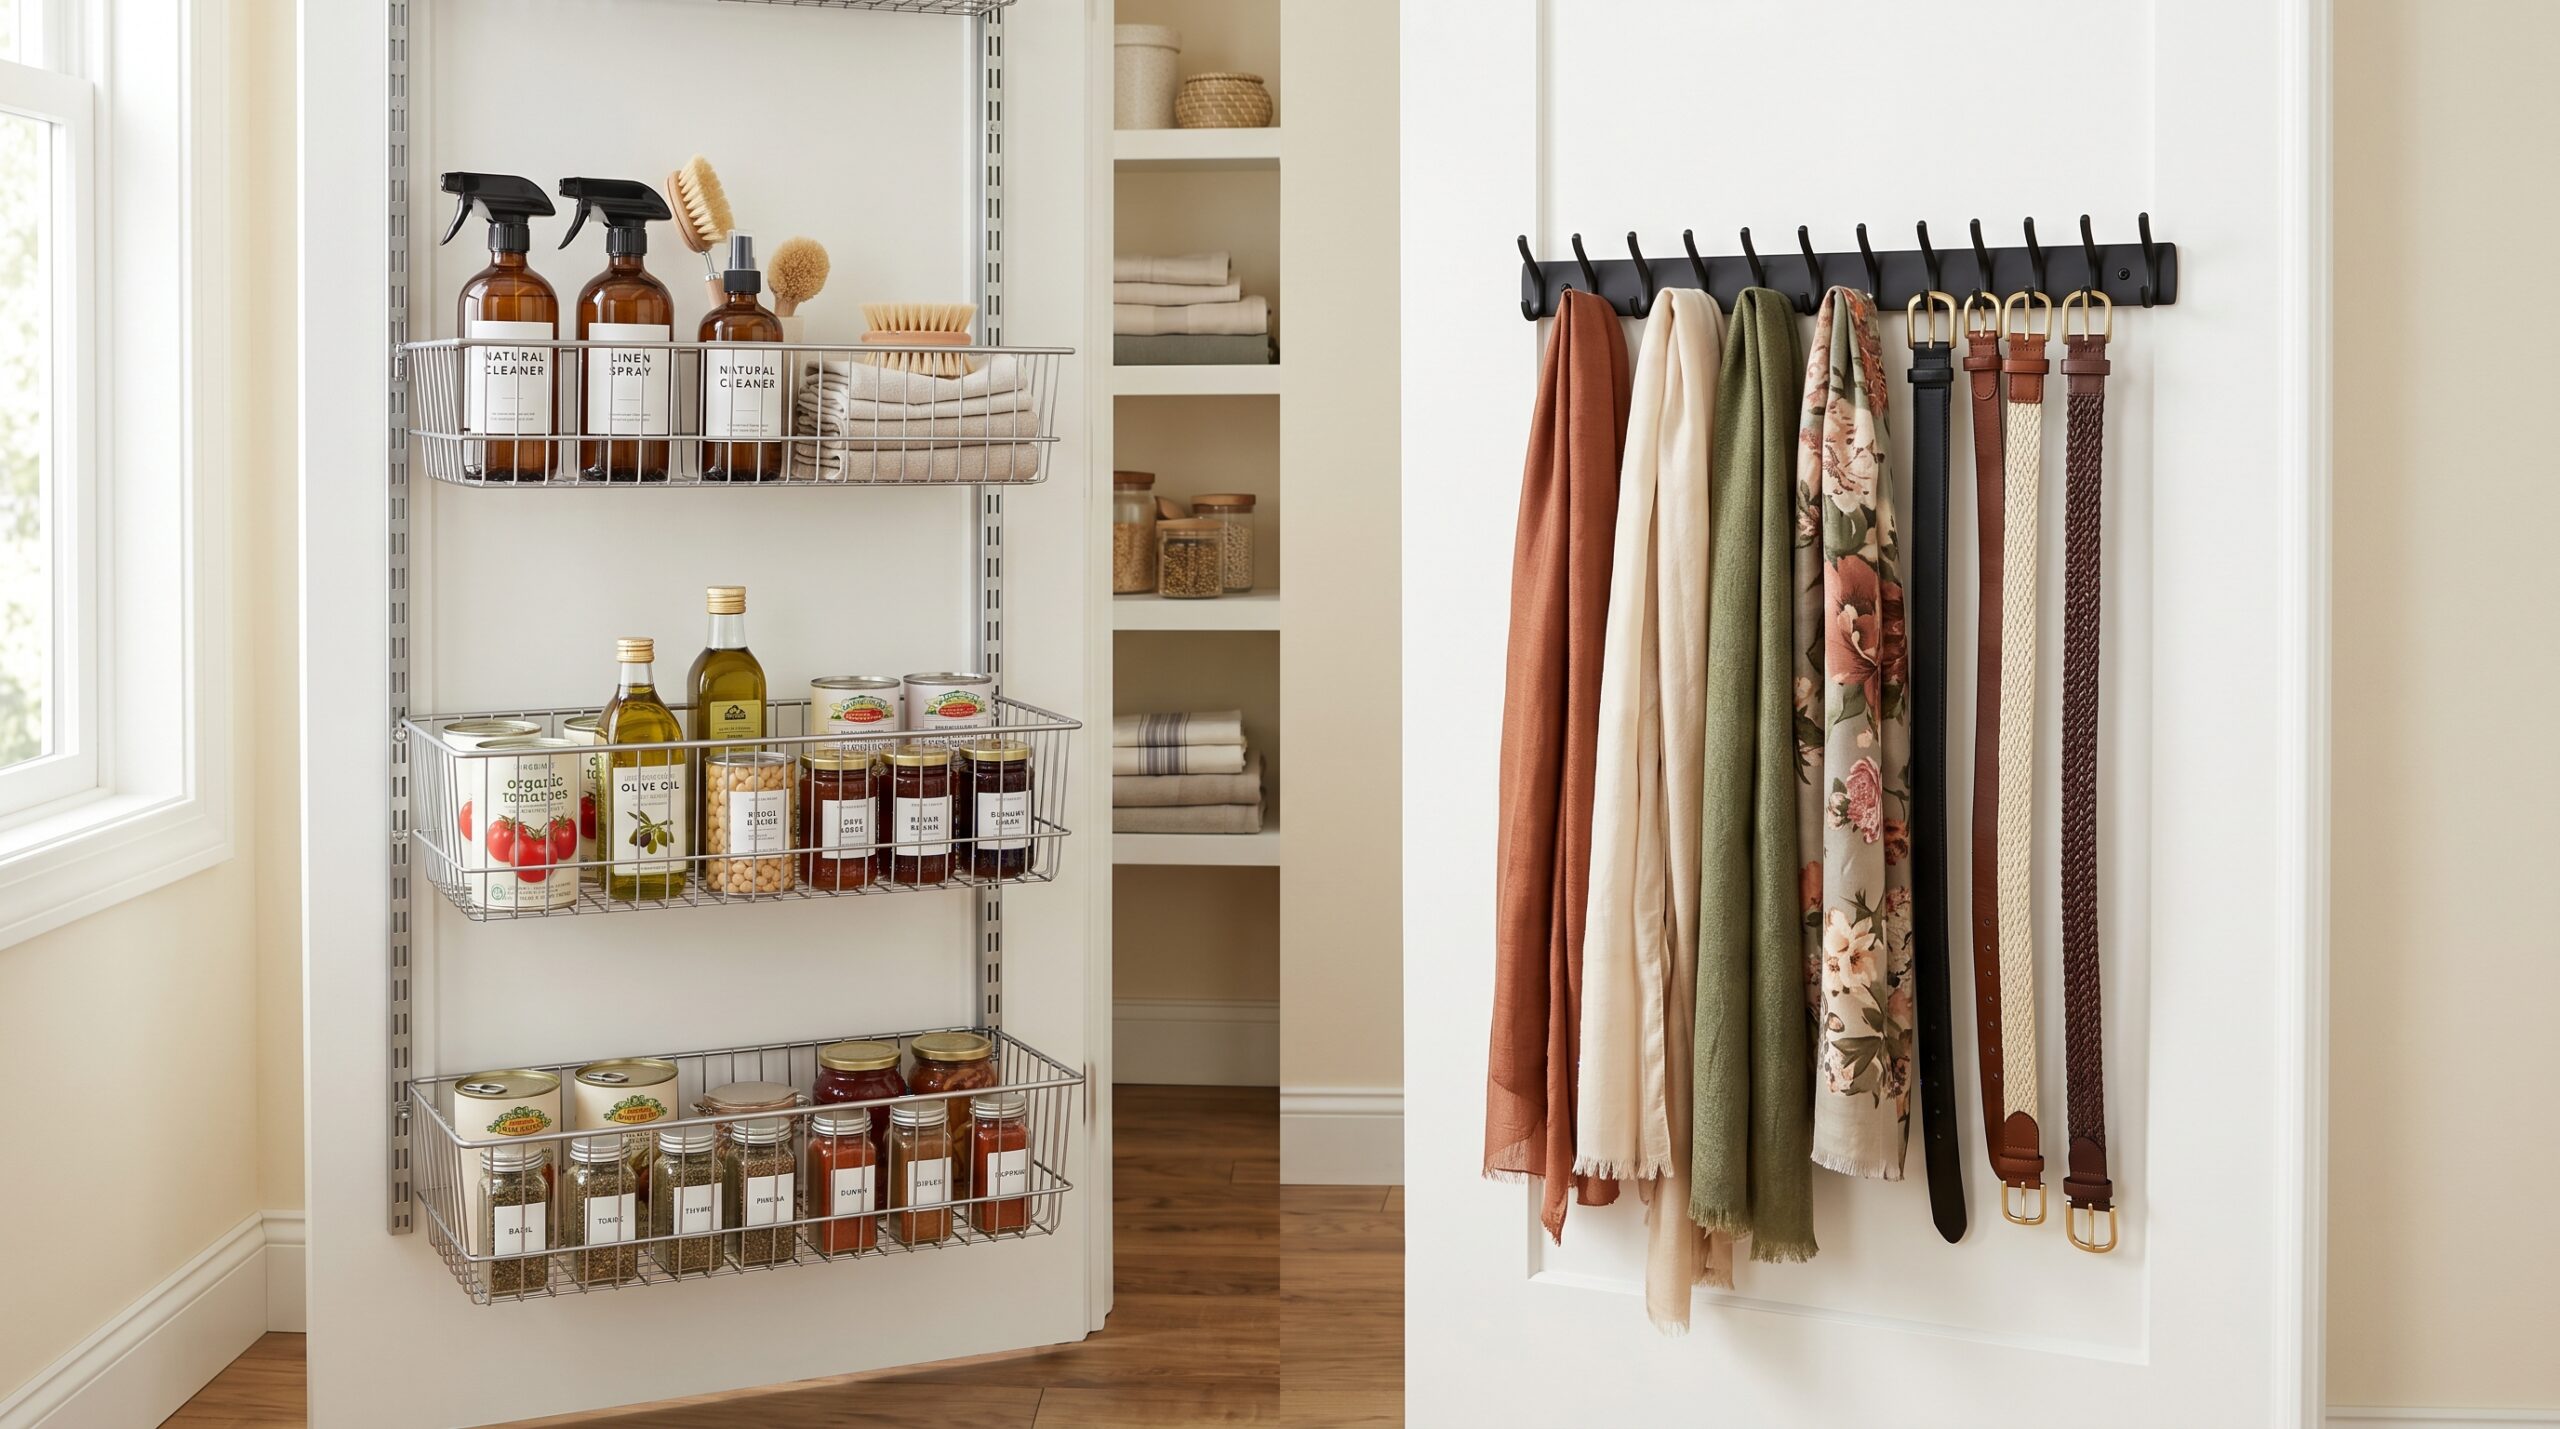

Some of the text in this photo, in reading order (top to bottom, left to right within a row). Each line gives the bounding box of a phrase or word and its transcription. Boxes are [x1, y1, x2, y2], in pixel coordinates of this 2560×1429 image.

[483, 351, 544, 362] NATURAL
[611, 353, 651, 363] LINEN
[485, 365, 544, 376] CLEANER
[609, 367, 651, 377] SPRAY
[720, 365, 775, 375] NATURAL
[507, 773, 563, 792] organic
[621, 782, 656, 792] OLVE
